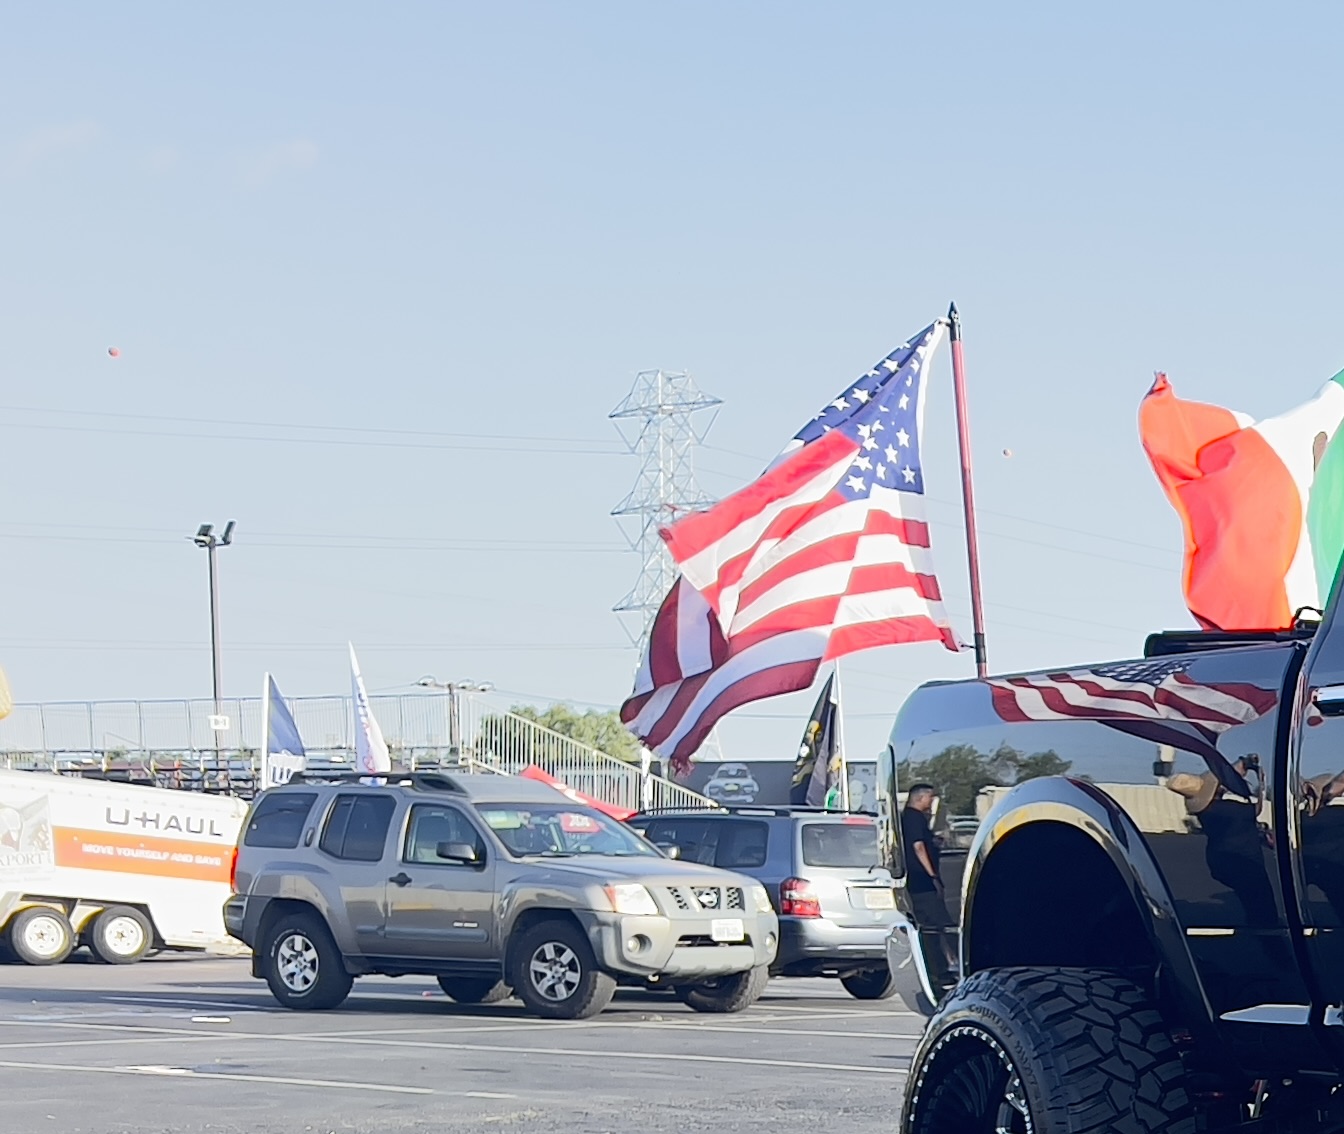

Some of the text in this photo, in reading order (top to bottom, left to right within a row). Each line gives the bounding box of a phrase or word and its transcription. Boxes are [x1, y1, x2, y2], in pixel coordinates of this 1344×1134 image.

[106, 807, 222, 837] U-HAUL
[82, 843, 221, 866] MOVE YOURSELF AND SAVE
